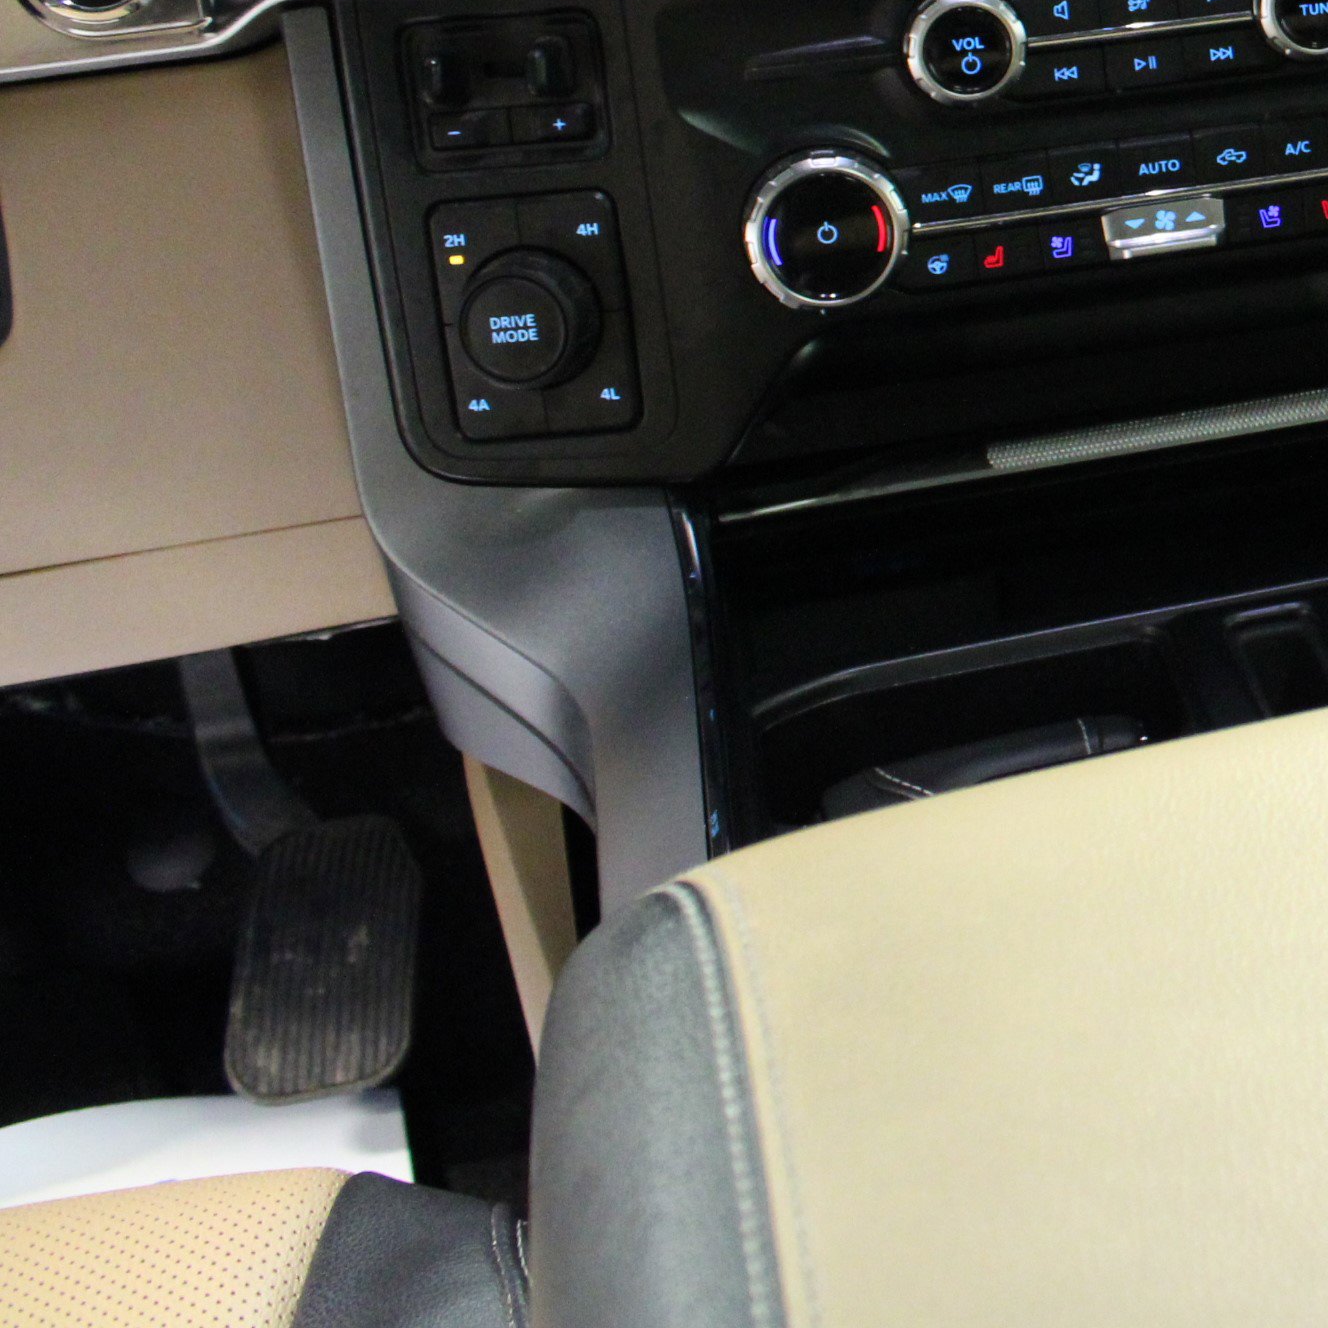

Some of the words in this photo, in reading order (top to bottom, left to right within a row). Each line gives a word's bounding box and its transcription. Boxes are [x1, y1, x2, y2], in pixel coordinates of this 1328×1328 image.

[952, 36, 985, 53] VOL
[1285, 140, 1311, 156] A/C
[1138, 158, 1180, 177] AUTO
[993, 182, 1021, 195] REAR
[921, 190, 949, 204] MAX
[576, 222, 599, 237] 4H
[443, 233, 466, 249] 2H
[489, 313, 537, 331] DRIVE
[492, 327, 539, 344] MODE
[600, 387, 621, 402] 4L
[468, 398, 491, 413] 4A
